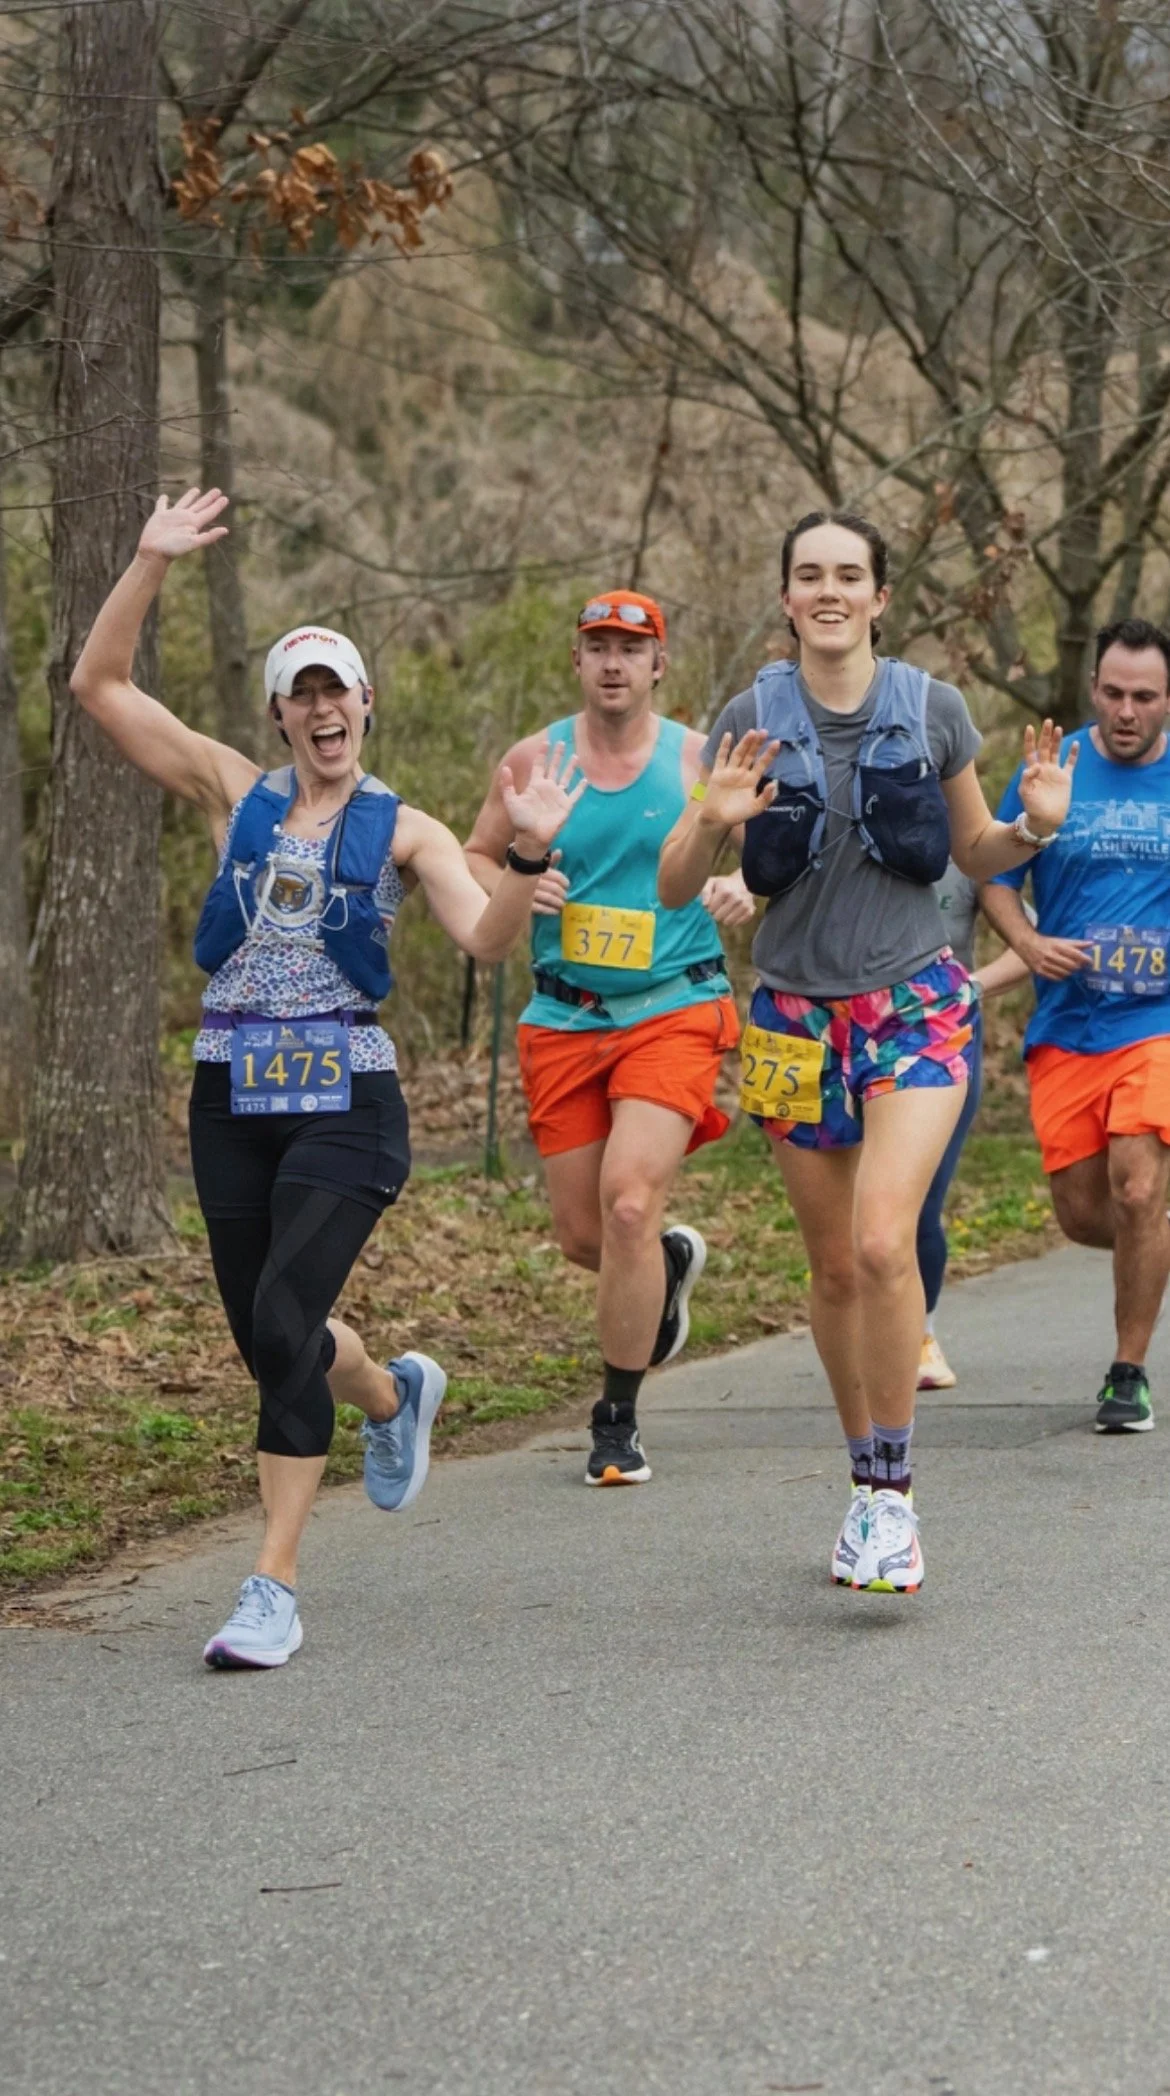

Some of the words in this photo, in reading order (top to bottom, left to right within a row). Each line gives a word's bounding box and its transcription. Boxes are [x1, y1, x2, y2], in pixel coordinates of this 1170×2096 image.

[1091, 841, 1169, 854] ASHEVILLE
[573, 928, 635, 962] 377
[1092, 944, 1165, 976] 1478
[242, 1050, 342, 1088] 1475
[743, 1053, 802, 1097] 275
[240, 1102, 266, 1113] 1475
